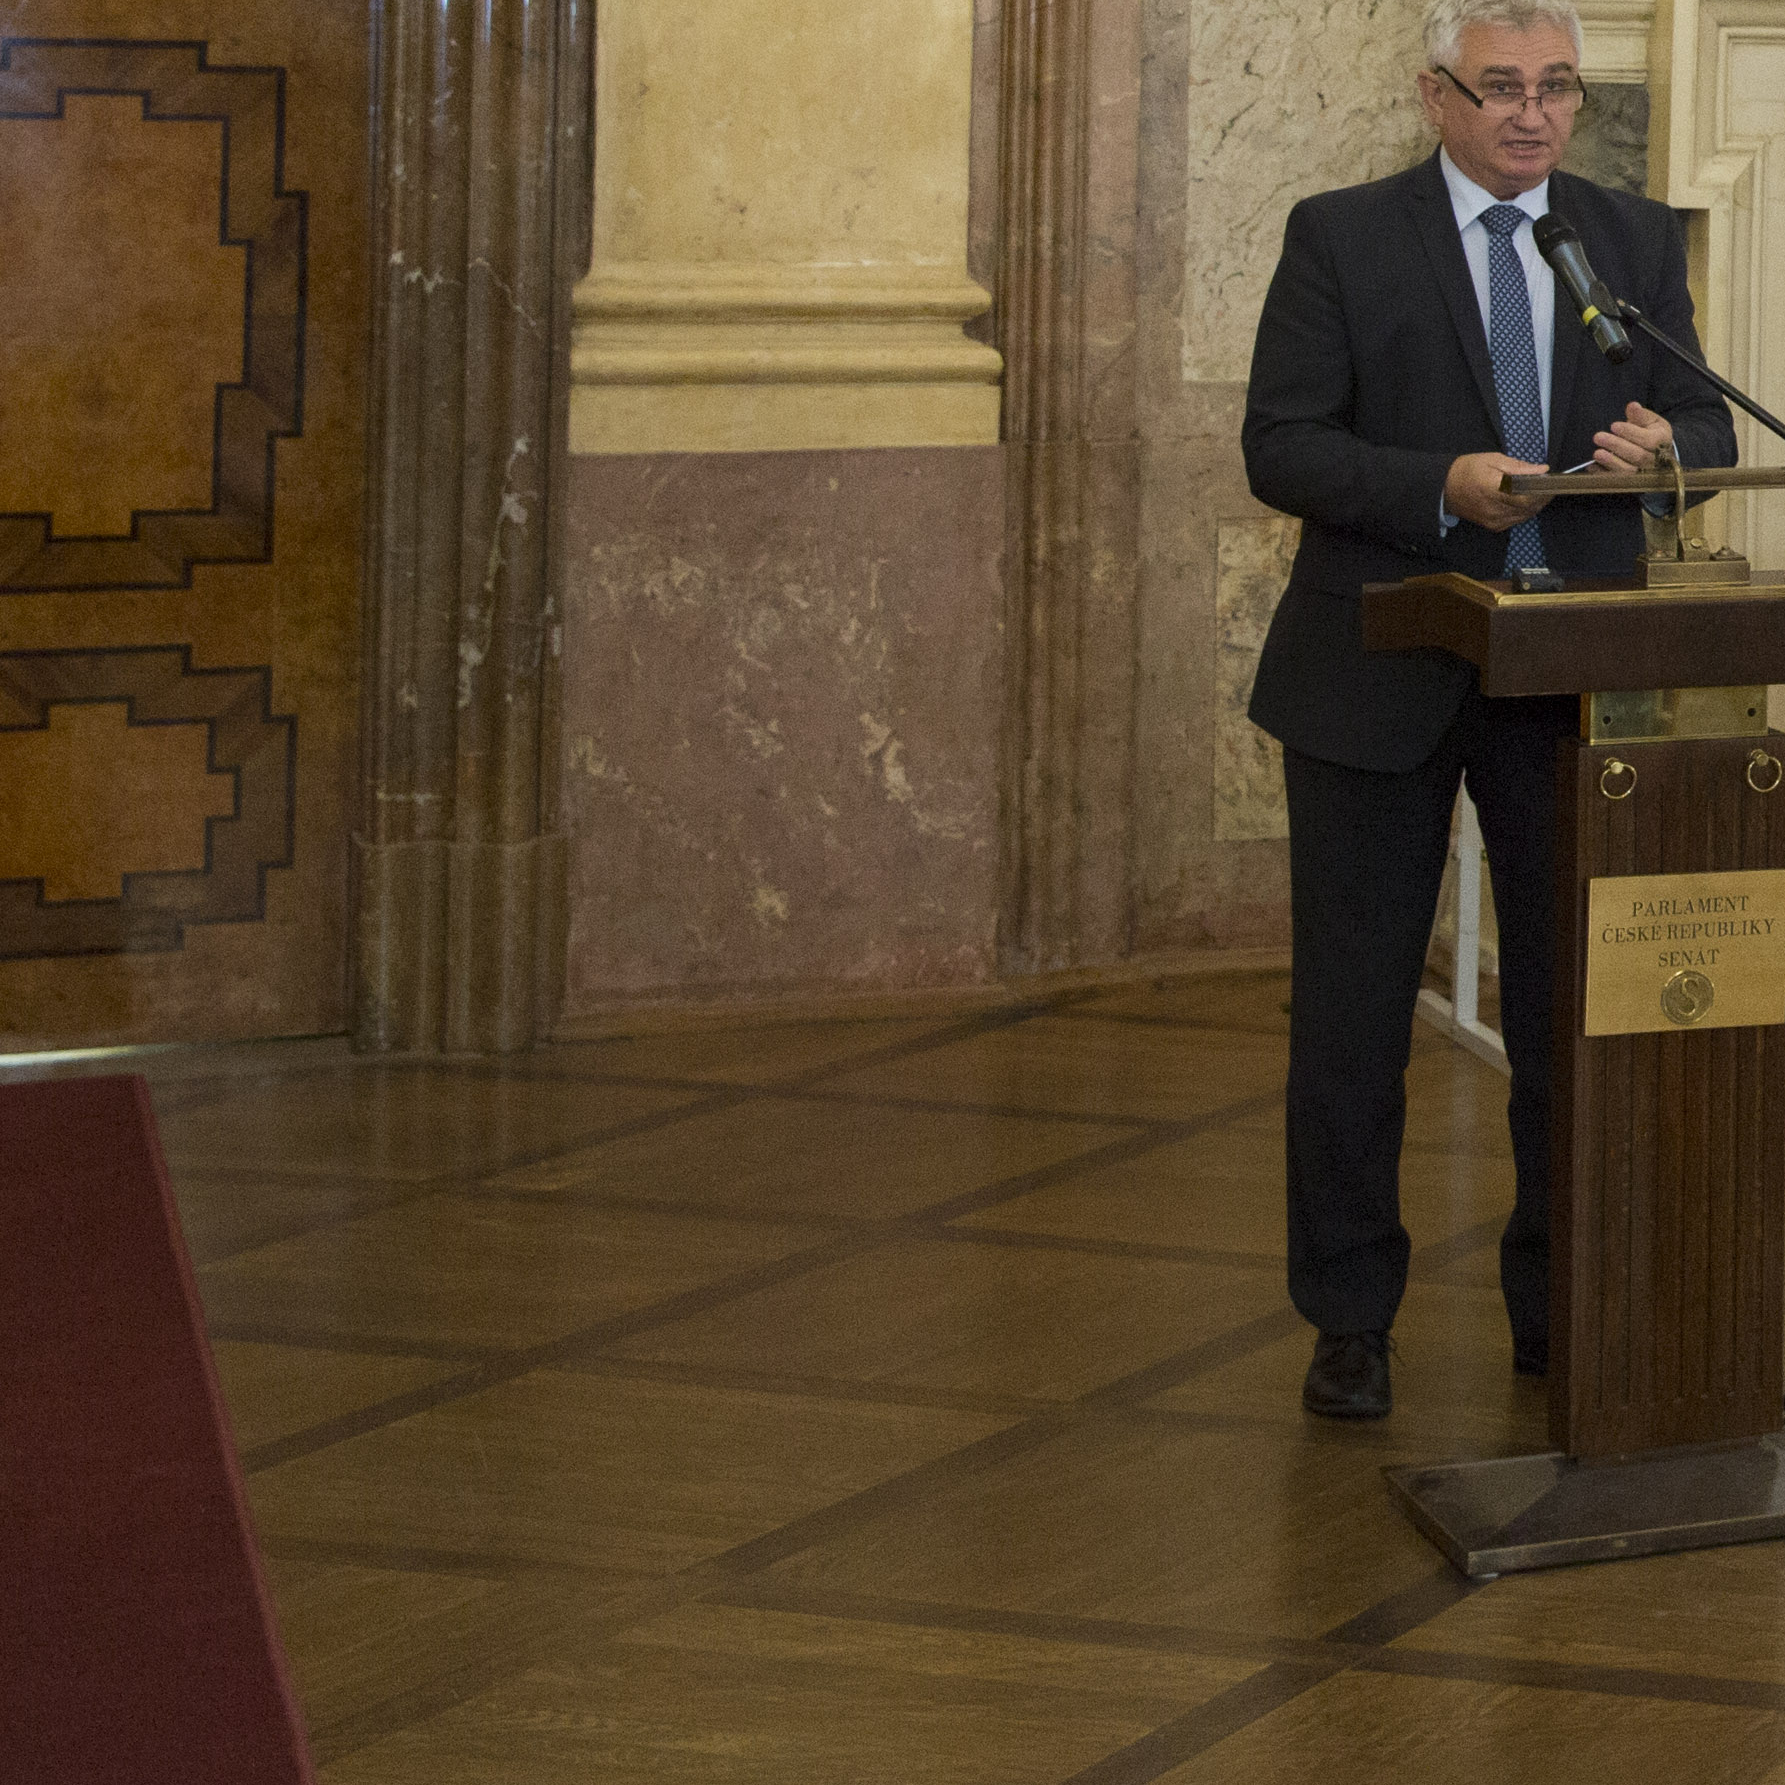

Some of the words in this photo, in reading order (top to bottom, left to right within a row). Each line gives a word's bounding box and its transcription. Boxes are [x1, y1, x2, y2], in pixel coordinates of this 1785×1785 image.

[1631, 894, 1749, 917] PARLAMENT
[1602, 921, 1661, 944] ČESKÉ
[1667, 918, 1775, 940] REPUBLIKY
